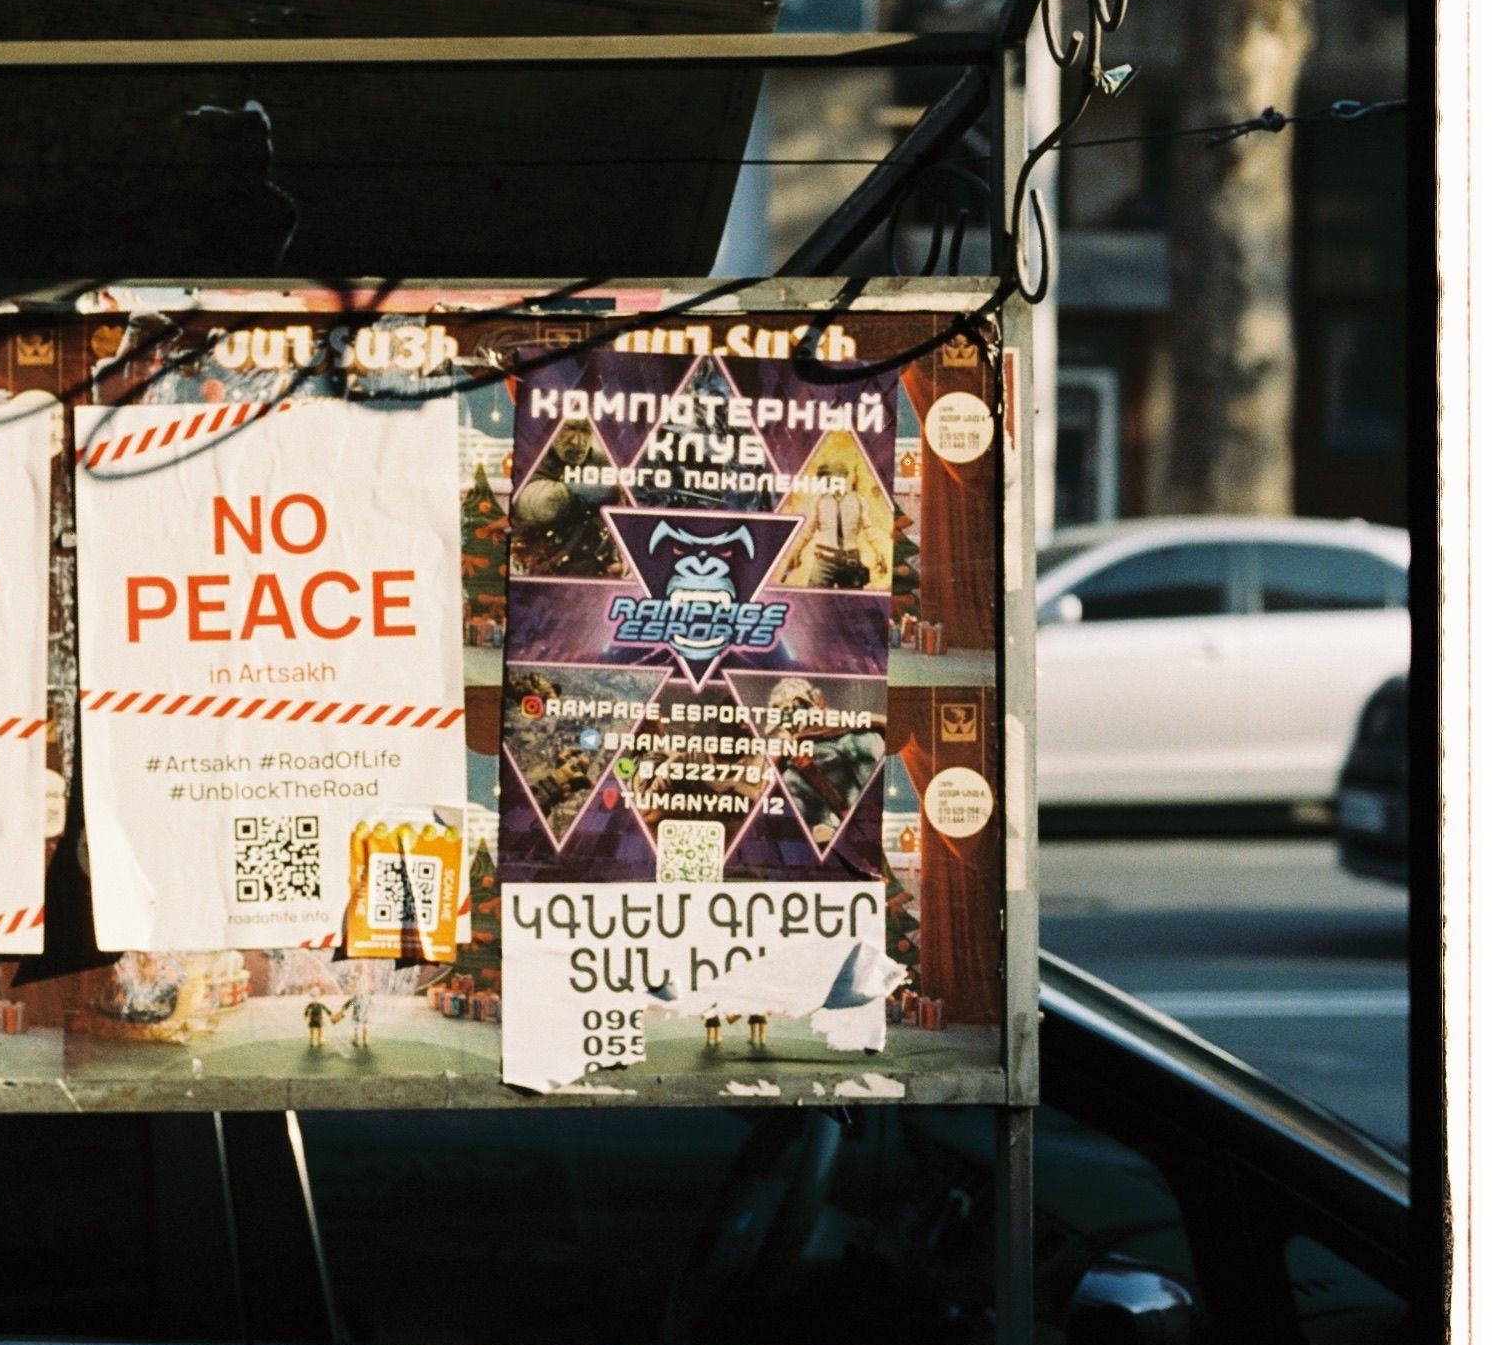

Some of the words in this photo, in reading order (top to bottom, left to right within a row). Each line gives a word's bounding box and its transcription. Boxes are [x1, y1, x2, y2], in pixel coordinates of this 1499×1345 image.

[530, 388, 884, 433] КОМПЮТЕРНЫЙ
[647, 431, 766, 465] КЛУБ
[564, 464, 672, 489] НОВОГО
[683, 469, 848, 494] ПОКОЛЕНИЯ
[213, 493, 328, 556] NO
[126, 570, 417, 644] PEACE
[609, 596, 788, 626] RAMPAGE
[615, 619, 775, 646] ESPORTS
[209, 663, 232, 685] in
[239, 661, 337, 684] Artsakh
[546, 698, 872, 730] RAMPAGE_ESPORTS_ARENA
[603, 731, 815, 758] @RAMPAGEARENA
[146, 753, 252, 774] #Artsakh
[258, 749, 402, 771] #RoadOfLife
[638, 760, 775, 784] 043227704
[169, 779, 380, 802] #UnblockTheRoad
[621, 791, 750, 814] TUMANYAN
[761, 795, 784, 816] 12
[512, 892, 692, 939] ԿԳՆԵՄ
[708, 892, 878, 938] ԳՐՔԵՐ
[569, 946, 672, 993] ՏԱՆ
